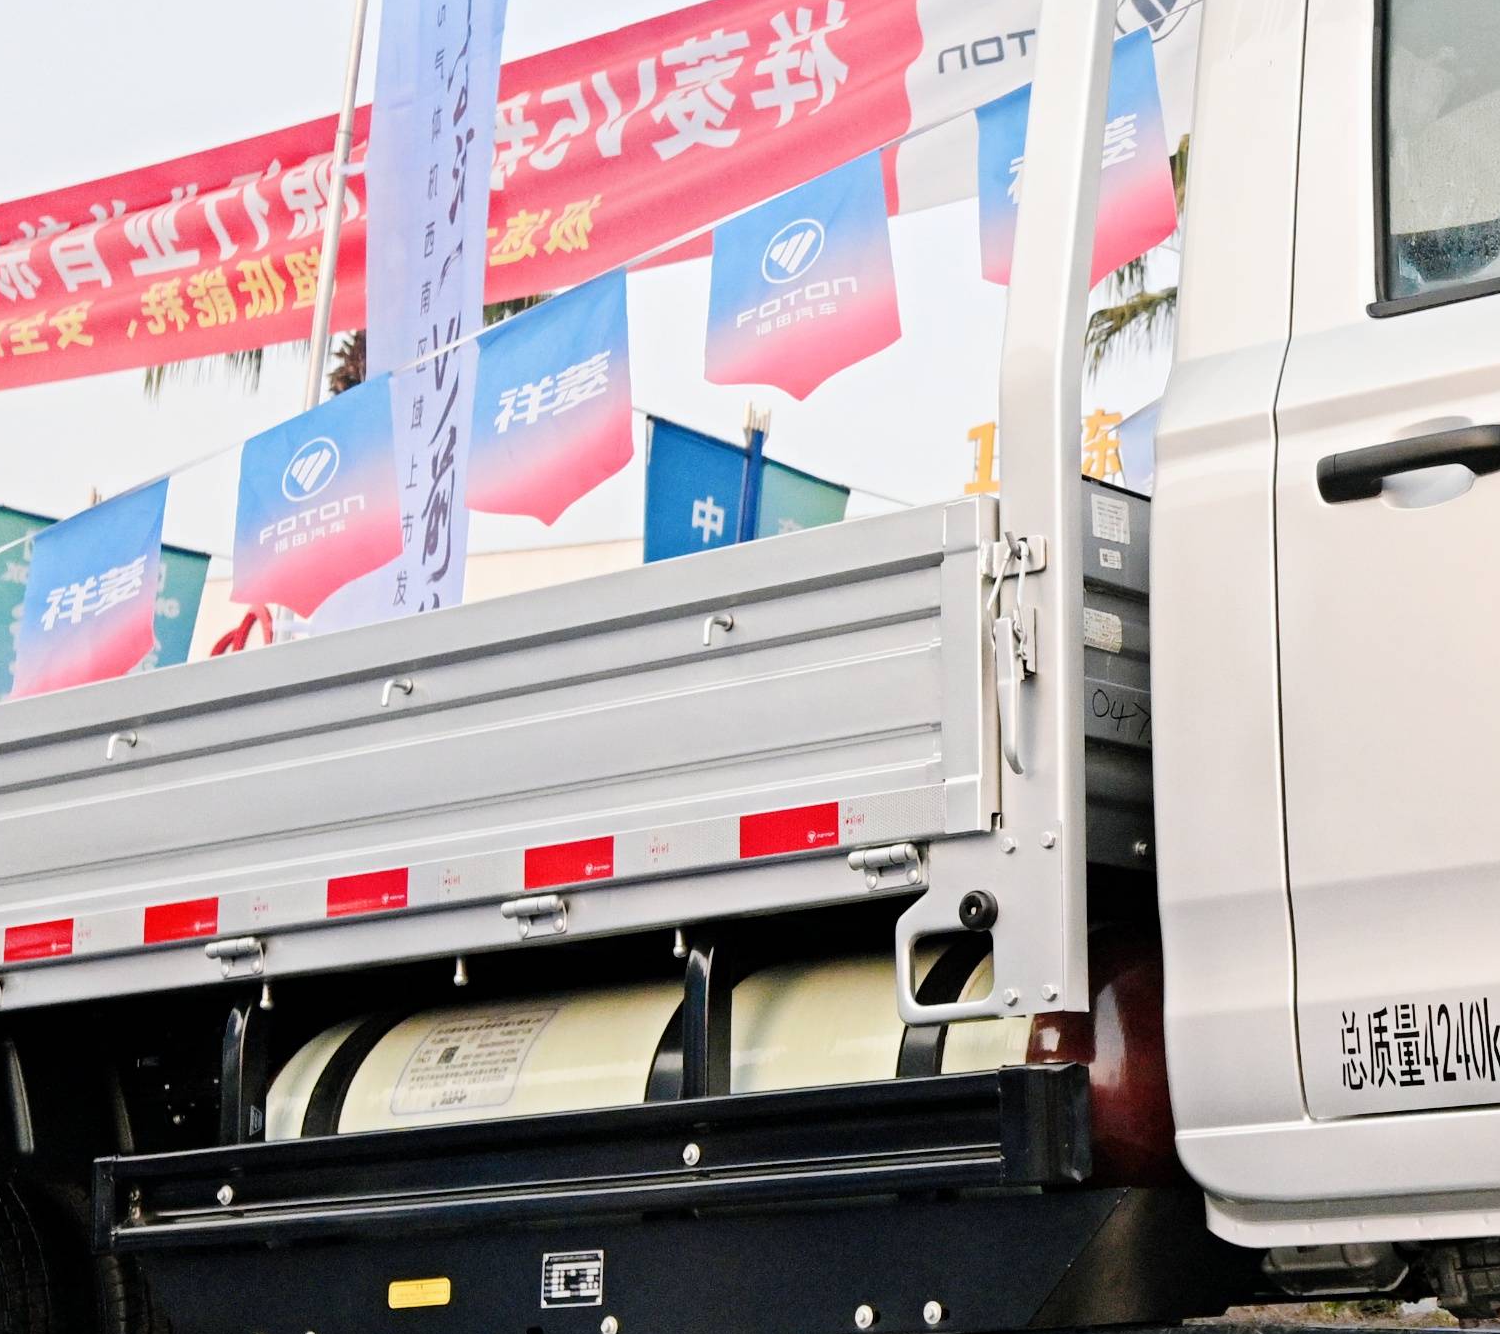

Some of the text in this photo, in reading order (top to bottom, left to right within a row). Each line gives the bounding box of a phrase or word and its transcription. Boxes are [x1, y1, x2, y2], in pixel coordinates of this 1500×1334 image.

[736, 275, 858, 329] FOTON
[753, 300, 838, 339] 福田汽车
[494, 349, 612, 434] 祥菱
[259, 493, 365, 545] FOTON
[273, 519, 348, 555] 福田汽车
[41, 555, 147, 631] 祥菱
